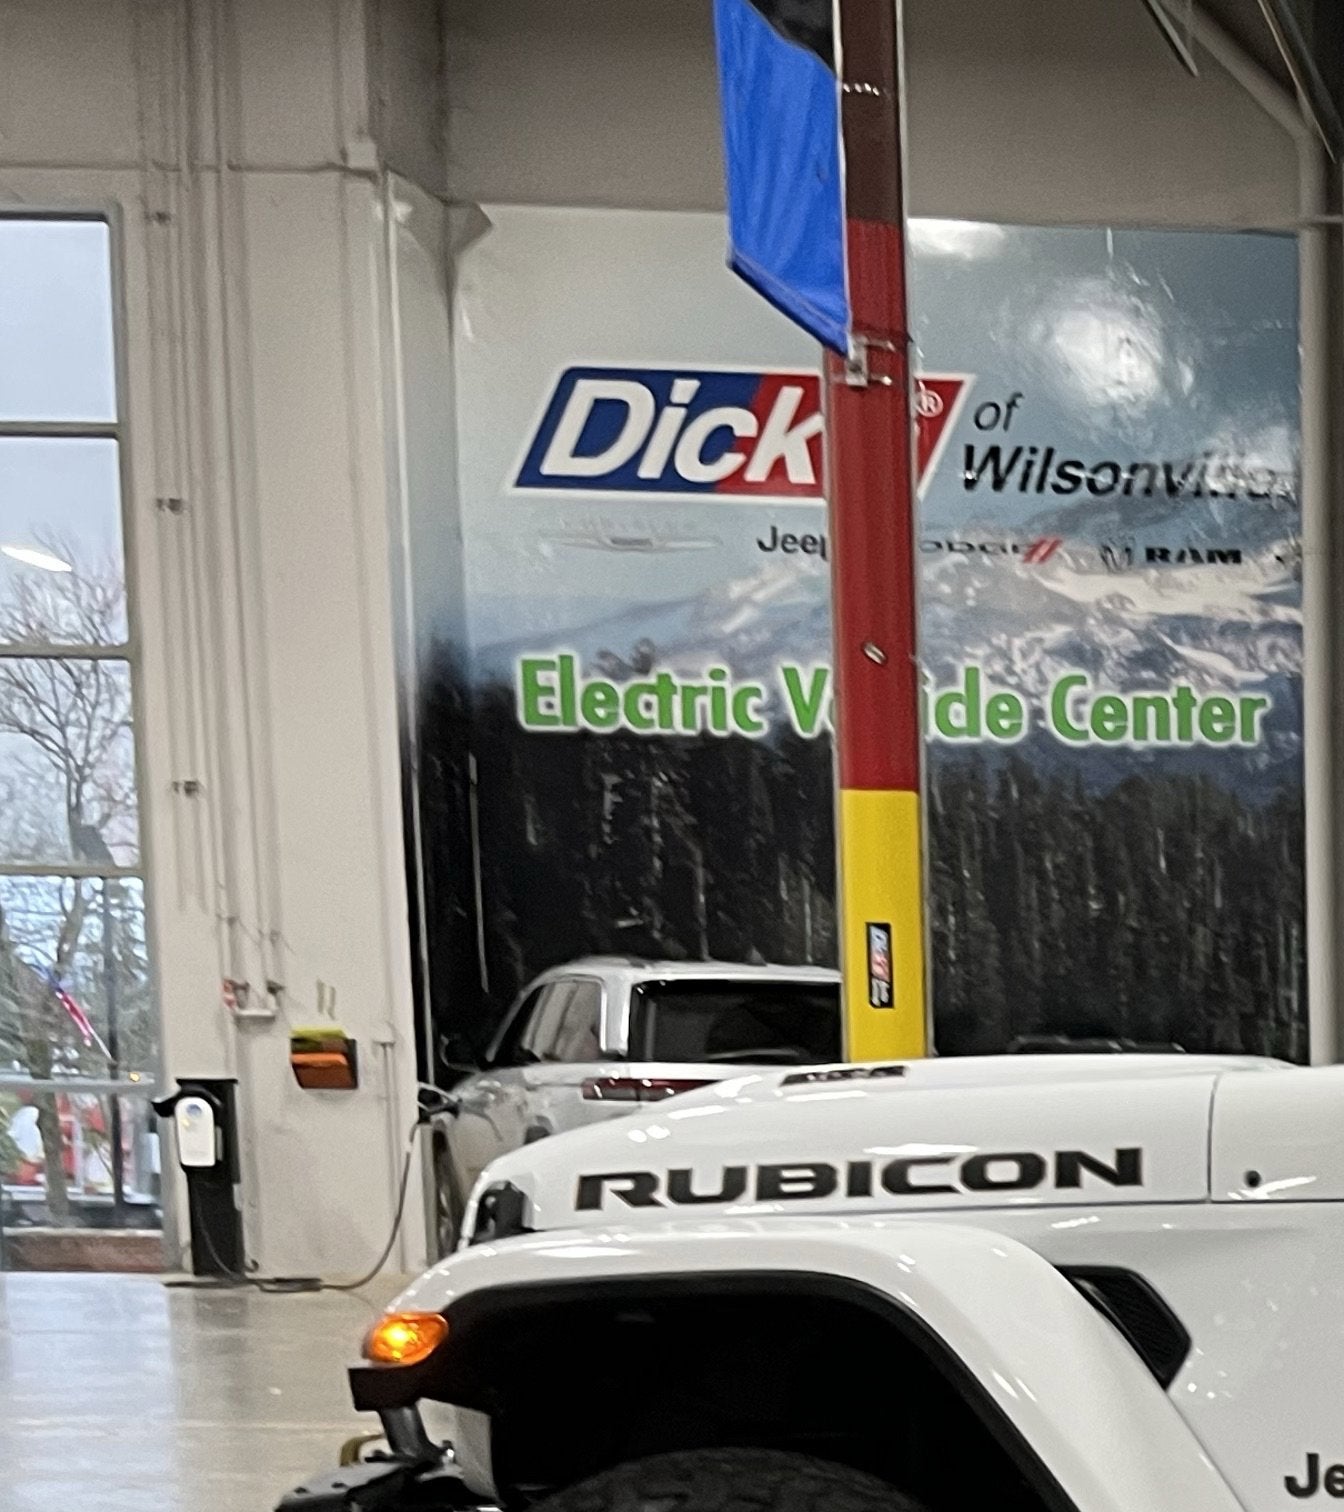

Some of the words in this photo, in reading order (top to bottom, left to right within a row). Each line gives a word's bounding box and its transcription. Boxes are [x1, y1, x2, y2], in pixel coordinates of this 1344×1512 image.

[539, 379, 826, 484] Dick
[974, 392, 1024, 432] of
[963, 443, 1286, 499] Wilsonvi
[757, 526, 826, 555] Jee
[1145, 545, 1242, 565] RAM
[521, 655, 763, 732] Electric
[782, 667, 1023, 738] Vcle
[1051, 675, 1267, 743] Center
[574, 1147, 1143, 1211] RUBICON
